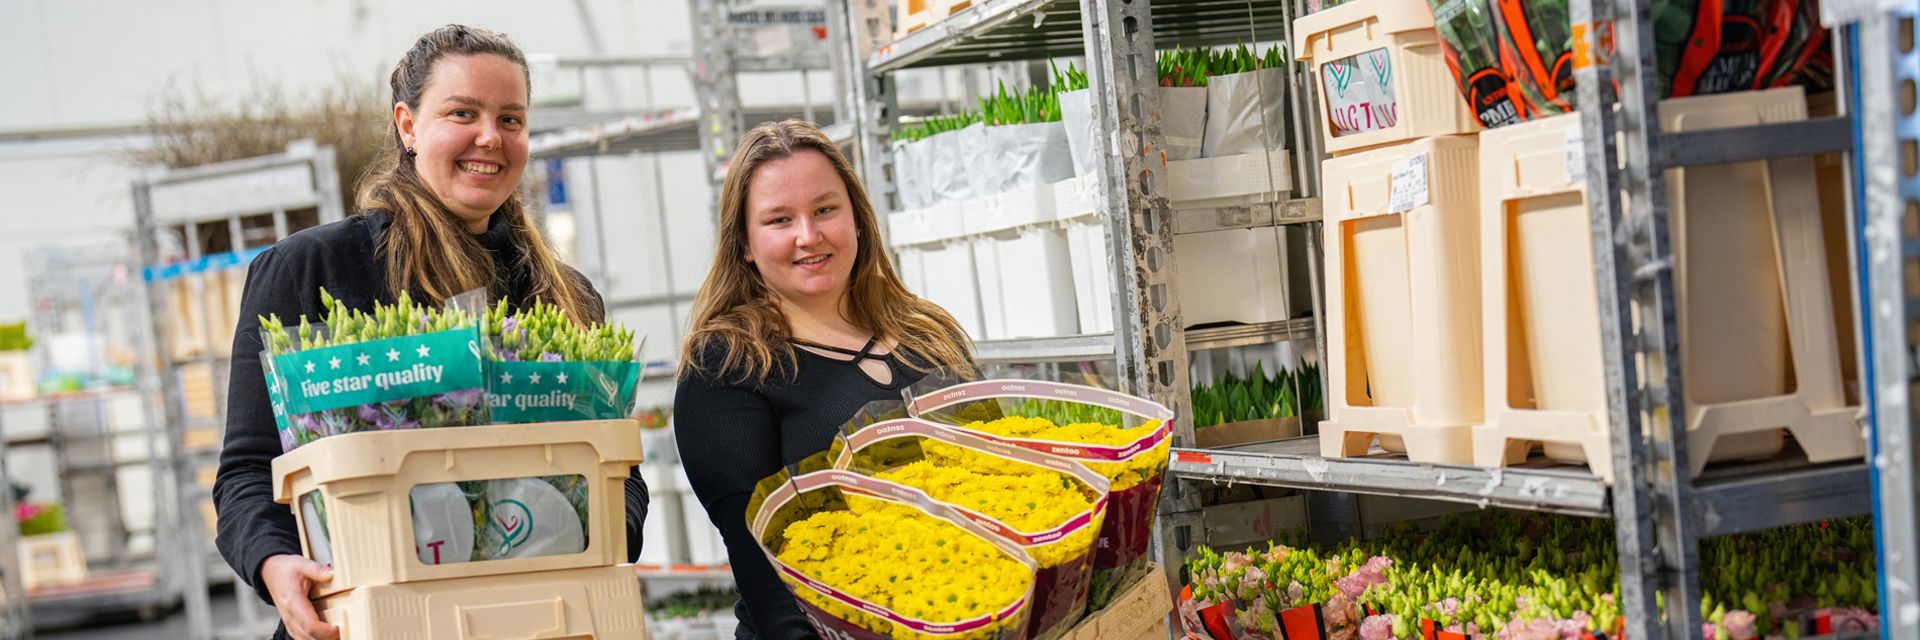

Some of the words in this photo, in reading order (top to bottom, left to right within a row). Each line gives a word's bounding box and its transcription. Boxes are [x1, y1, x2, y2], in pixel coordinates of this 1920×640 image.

[301, 379, 331, 398] Five
[333, 375, 372, 393] star
[375, 363, 443, 391] quality
[514, 389, 577, 411] quality
[1051, 446, 1080, 455] zentoo
[1032, 531, 1063, 543] zentoo
